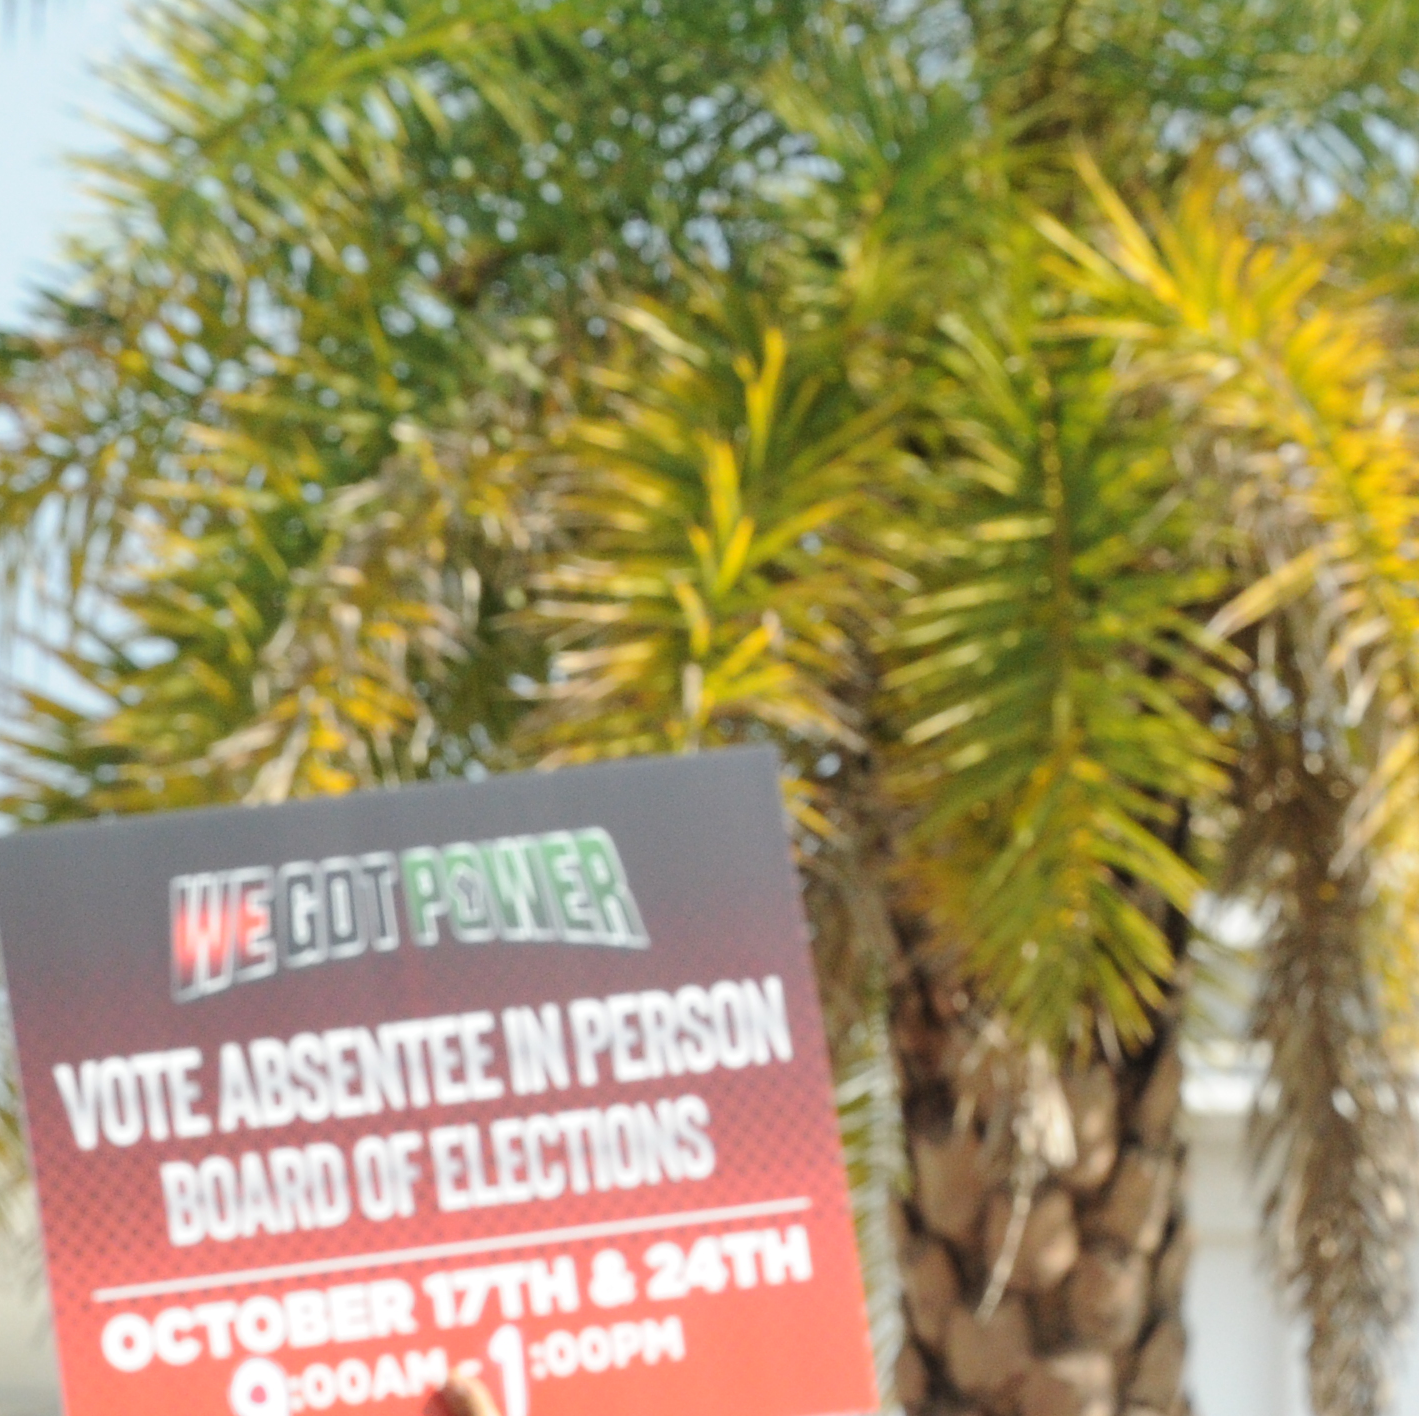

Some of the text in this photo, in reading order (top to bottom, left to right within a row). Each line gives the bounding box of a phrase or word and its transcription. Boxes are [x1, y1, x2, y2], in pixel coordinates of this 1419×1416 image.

[169, 826, 651, 1004] WE GOT POWER
[52, 975, 793, 1150] VOTE ABSENTEE IN PERSON
[160, 1094, 716, 1247] BOARD OF ELECTIONS
[100, 1225, 813, 1373] OCTOBER 17TH & 24TH
